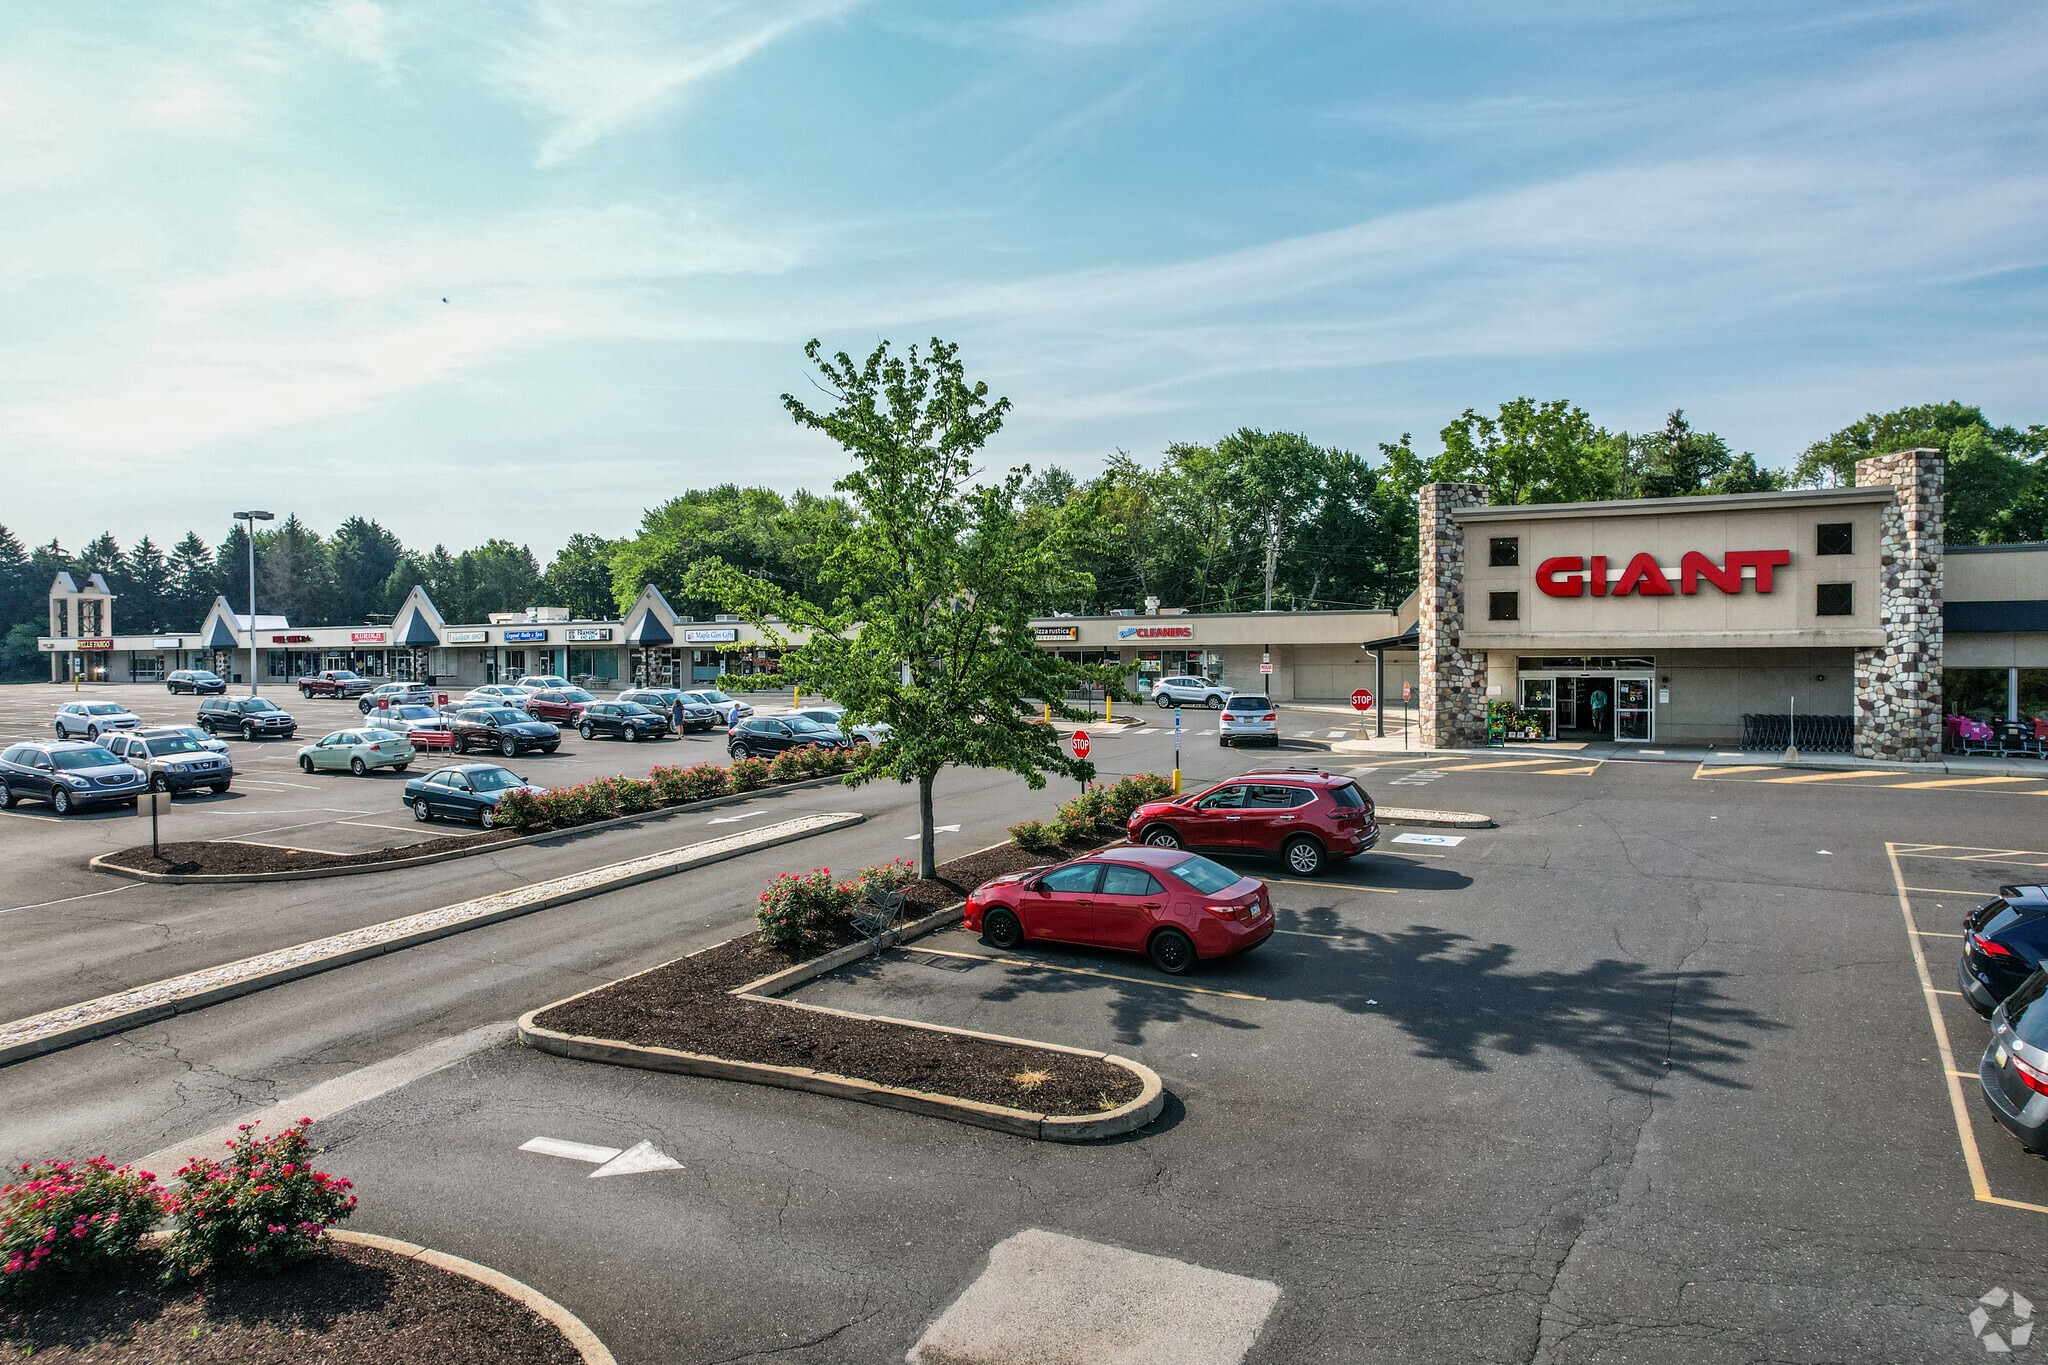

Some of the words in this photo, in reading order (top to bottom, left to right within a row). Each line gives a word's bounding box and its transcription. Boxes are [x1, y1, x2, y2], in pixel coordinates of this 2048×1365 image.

[1535, 549, 1790, 597] GIANT
[506, 631, 520, 639] Crystal
[695, 631, 710, 640] Maple
[710, 631, 721, 639] Glen
[722, 631, 734, 640] Gifts
[1049, 627, 1070, 635] rustica
[1137, 627, 1192, 637] CLEANERS
[1352, 695, 1372, 705] STOP
[1073, 738, 1089, 751] STOP
